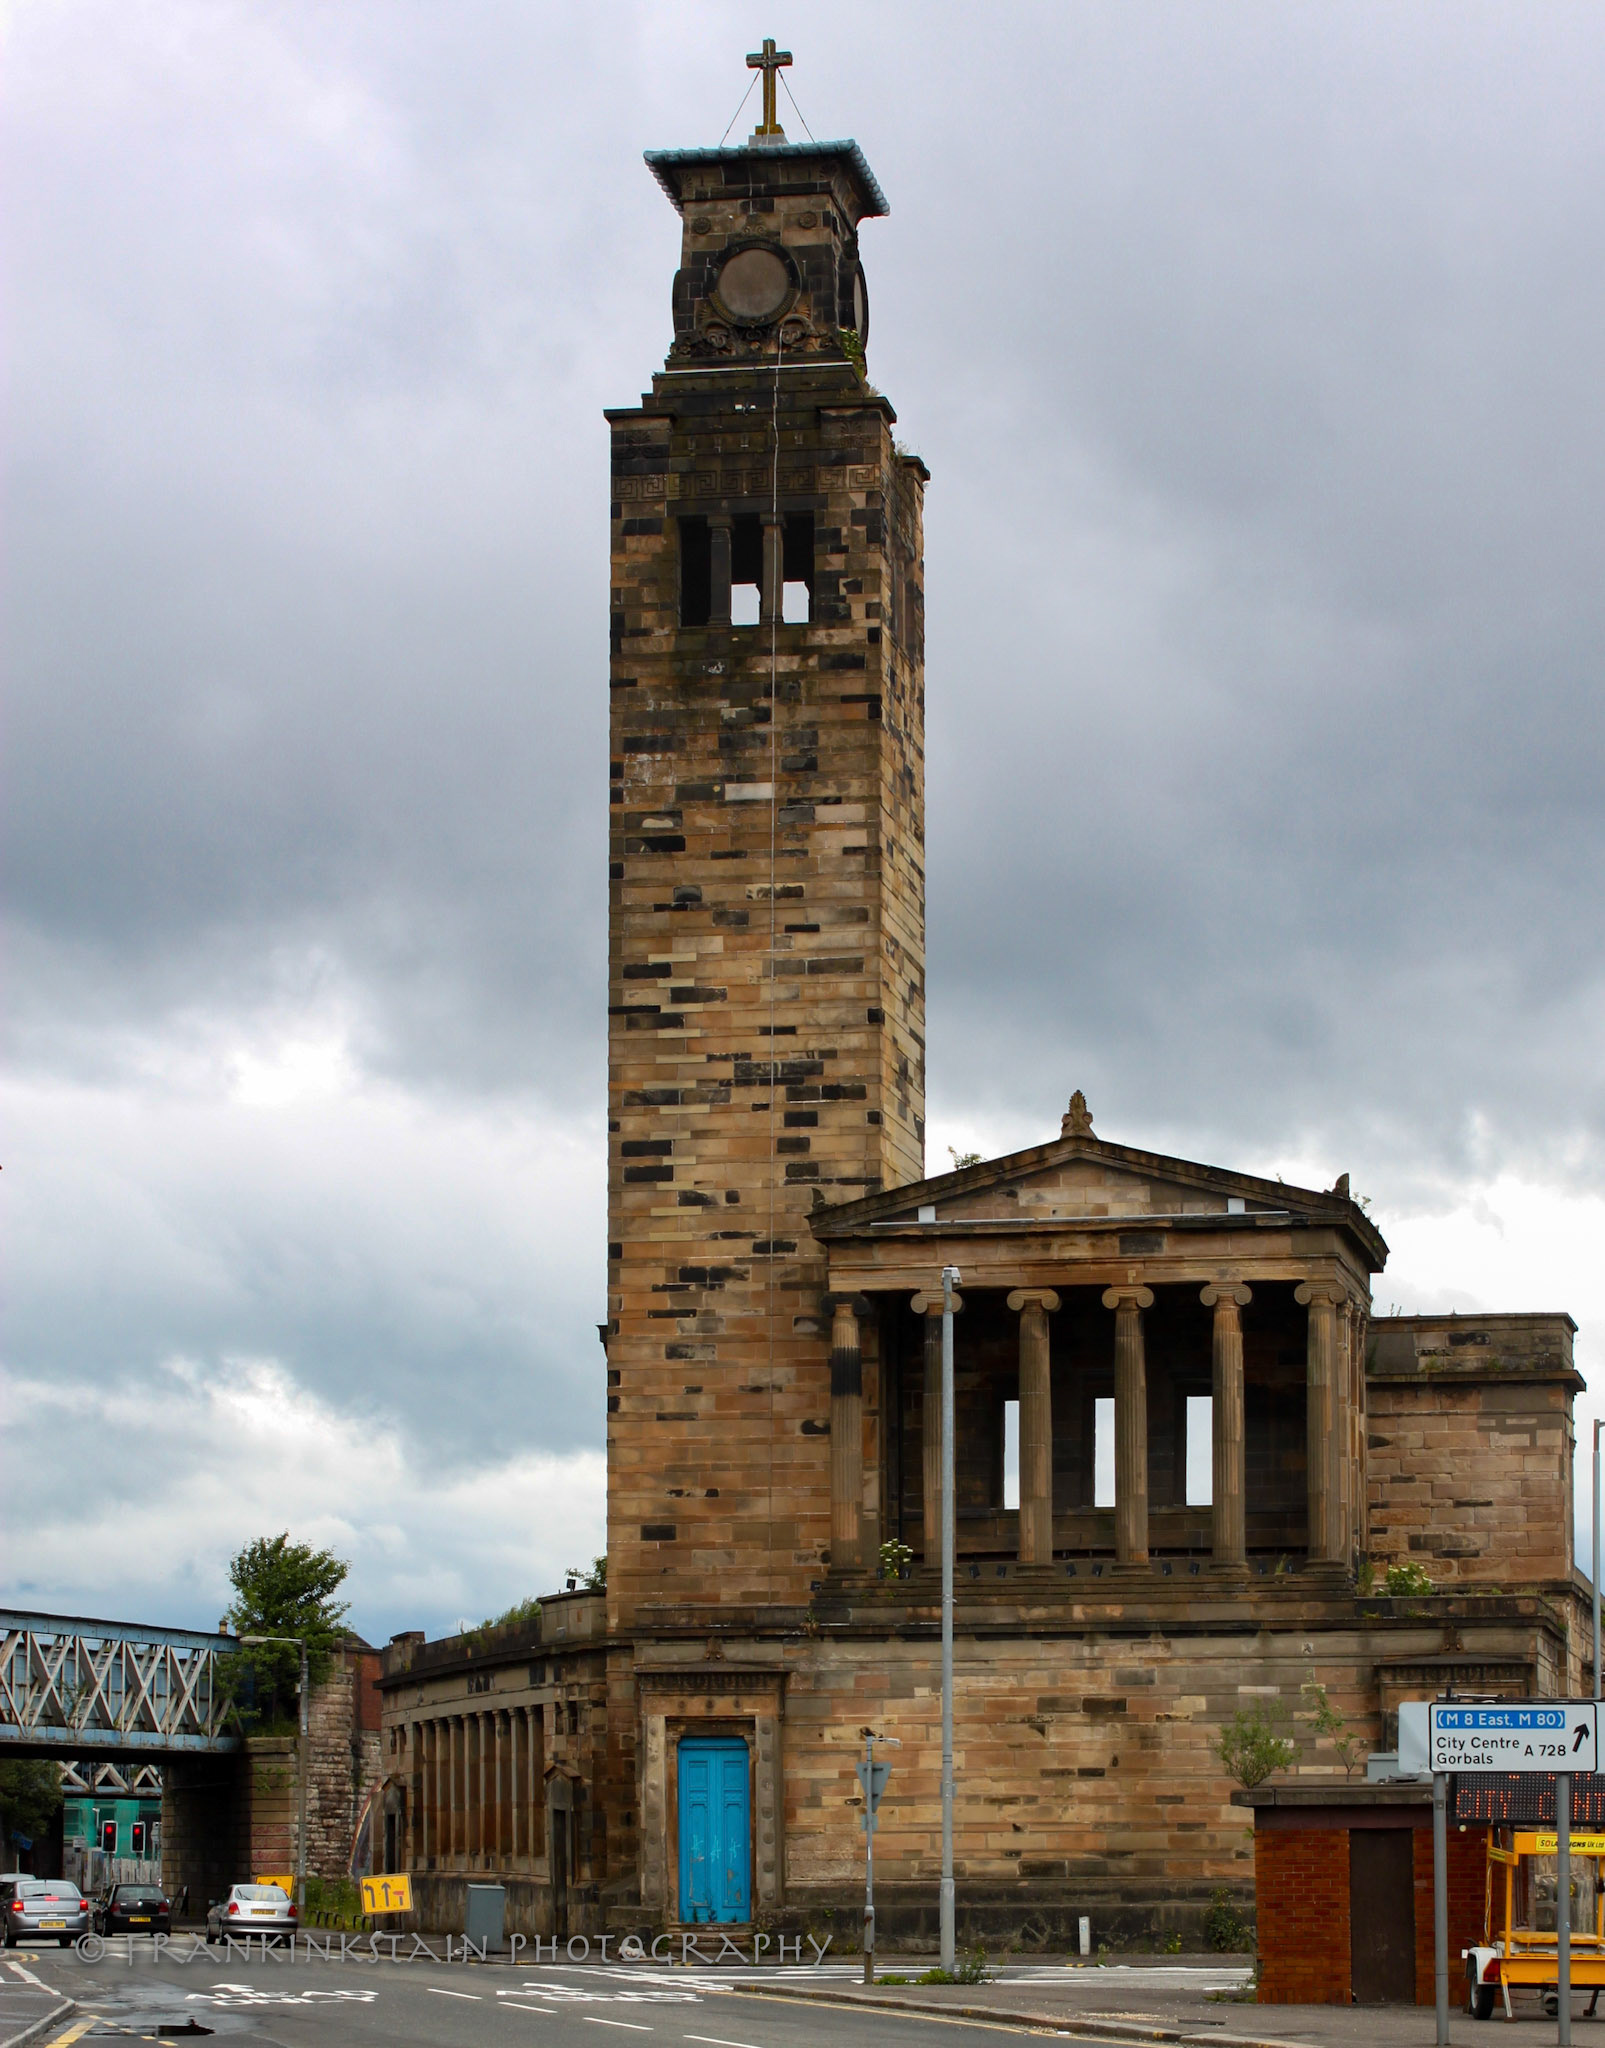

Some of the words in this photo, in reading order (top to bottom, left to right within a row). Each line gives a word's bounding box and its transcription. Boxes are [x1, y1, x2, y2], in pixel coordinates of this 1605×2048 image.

[1437, 1713, 1458, 1727] (M
[1464, 1713, 1473, 1726] 8
[1478, 1713, 1514, 1727] East,
[1519, 1713, 1531, 1726] M
[1536, 1712, 1564, 1727] 80)
[1436, 1737, 1465, 1751] City
[1471, 1737, 1520, 1749] Centre
[1524, 1745, 1534, 1757] A
[1539, 1744, 1567, 1757] 728
[1436, 1753, 1493, 1765] Gorbals
[1456, 1789, 1512, 1819] CITY
